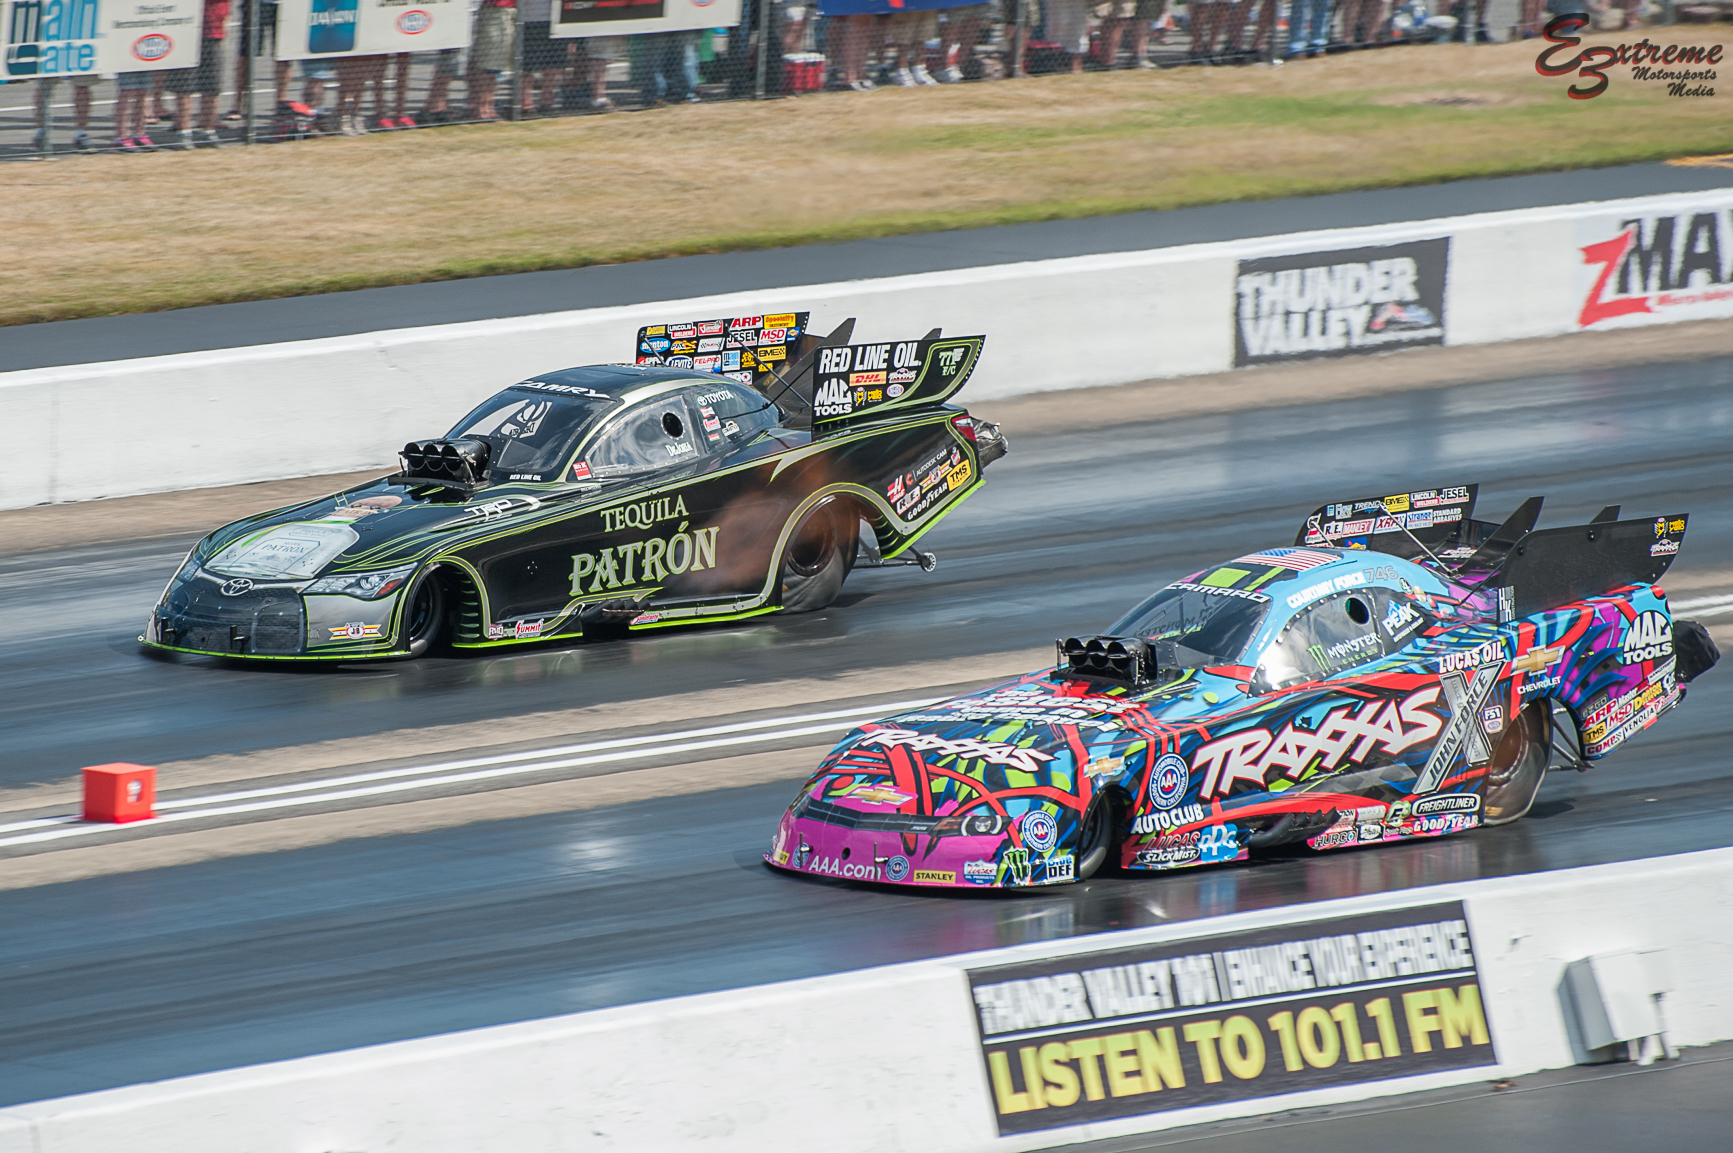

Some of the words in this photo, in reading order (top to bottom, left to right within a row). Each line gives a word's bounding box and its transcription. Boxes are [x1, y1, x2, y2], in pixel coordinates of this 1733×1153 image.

[1237, 257, 1420, 316] THUNDER
[669, 323, 692, 332] LINCOLN
[731, 315, 762, 328] ARP
[1239, 304, 1373, 356] VALLEY
[760, 329, 785, 340] MSD
[818, 347, 852, 374] RED
[854, 344, 891, 371] LINE
[854, 373, 882, 384] DHL
[942, 365, 956, 377] F/C
[513, 380, 611, 399] CAMRY
[706, 390, 735, 404] TOYOTA
[815, 377, 853, 407] MAC
[813, 403, 853, 417] TOOLS
[936, 448, 948, 460] CAM
[950, 463, 967, 483] TMS
[907, 481, 948, 520] GOODYEAR
[1411, 492, 1437, 501] LINCOLN
[1440, 487, 1468, 500] JESEL
[600, 494, 689, 532] TEQUILA
[1433, 507, 1462, 517] STANDARD
[568, 521, 720, 597] PATRÓN
[1363, 565, 1398, 583] 746
[1164, 582, 1272, 604] CAMARO
[1286, 578, 1335, 608] COURTNEY
[1333, 571, 1367, 590] FORCE
[1381, 602, 1420, 637] PEAK
[1624, 611, 1672, 652] MAC
[1326, 632, 1383, 659] MONSTER
[1341, 647, 1379, 664] ENERGY
[1623, 642, 1673, 665] TOOLS
[1438, 650, 1481, 674] LUCAS
[1482, 641, 1505, 664] OIL
[1516, 675, 1562, 695] CHEVROLET
[1484, 708, 1502, 720] FS1
[1583, 698, 1617, 729] ARP
[1608, 702, 1633, 727] MSD
[1624, 707, 1655, 733] VENOLIA
[1429, 730, 1457, 787] JOHN
[1454, 671, 1489, 734] FORCE
[1586, 725, 1605, 741] TMS
[860, 728, 1055, 772] TRAXXAS
[1190, 685, 1443, 800] TRAXXAS
[1586, 735, 1617, 755] COMP
[1161, 771, 1178, 788] AAA
[1418, 797, 1475, 813] FREIGHTLINER
[1130, 811, 1171, 834] AUTO
[1170, 802, 1205, 826] CLUB
[1413, 814, 1479, 832] GOODYEAR
[1033, 824, 1048, 836] AAA
[1315, 830, 1356, 847] HURCO
[1143, 831, 1201, 851] LUCAS
[915, 871, 955, 881] STANLEY
[967, 867, 994, 875] LUCAS
[1048, 864, 1072, 878] DEF
[1081, 959, 1175, 1019] VALLEY
[1356, 919, 1475, 980] EXPERIENCE
[988, 1026, 1186, 1115] LISTEN
[1183, 1014, 1267, 1085] TO
[1267, 997, 1402, 1073] 101.1
[1402, 984, 1491, 1054] FM
